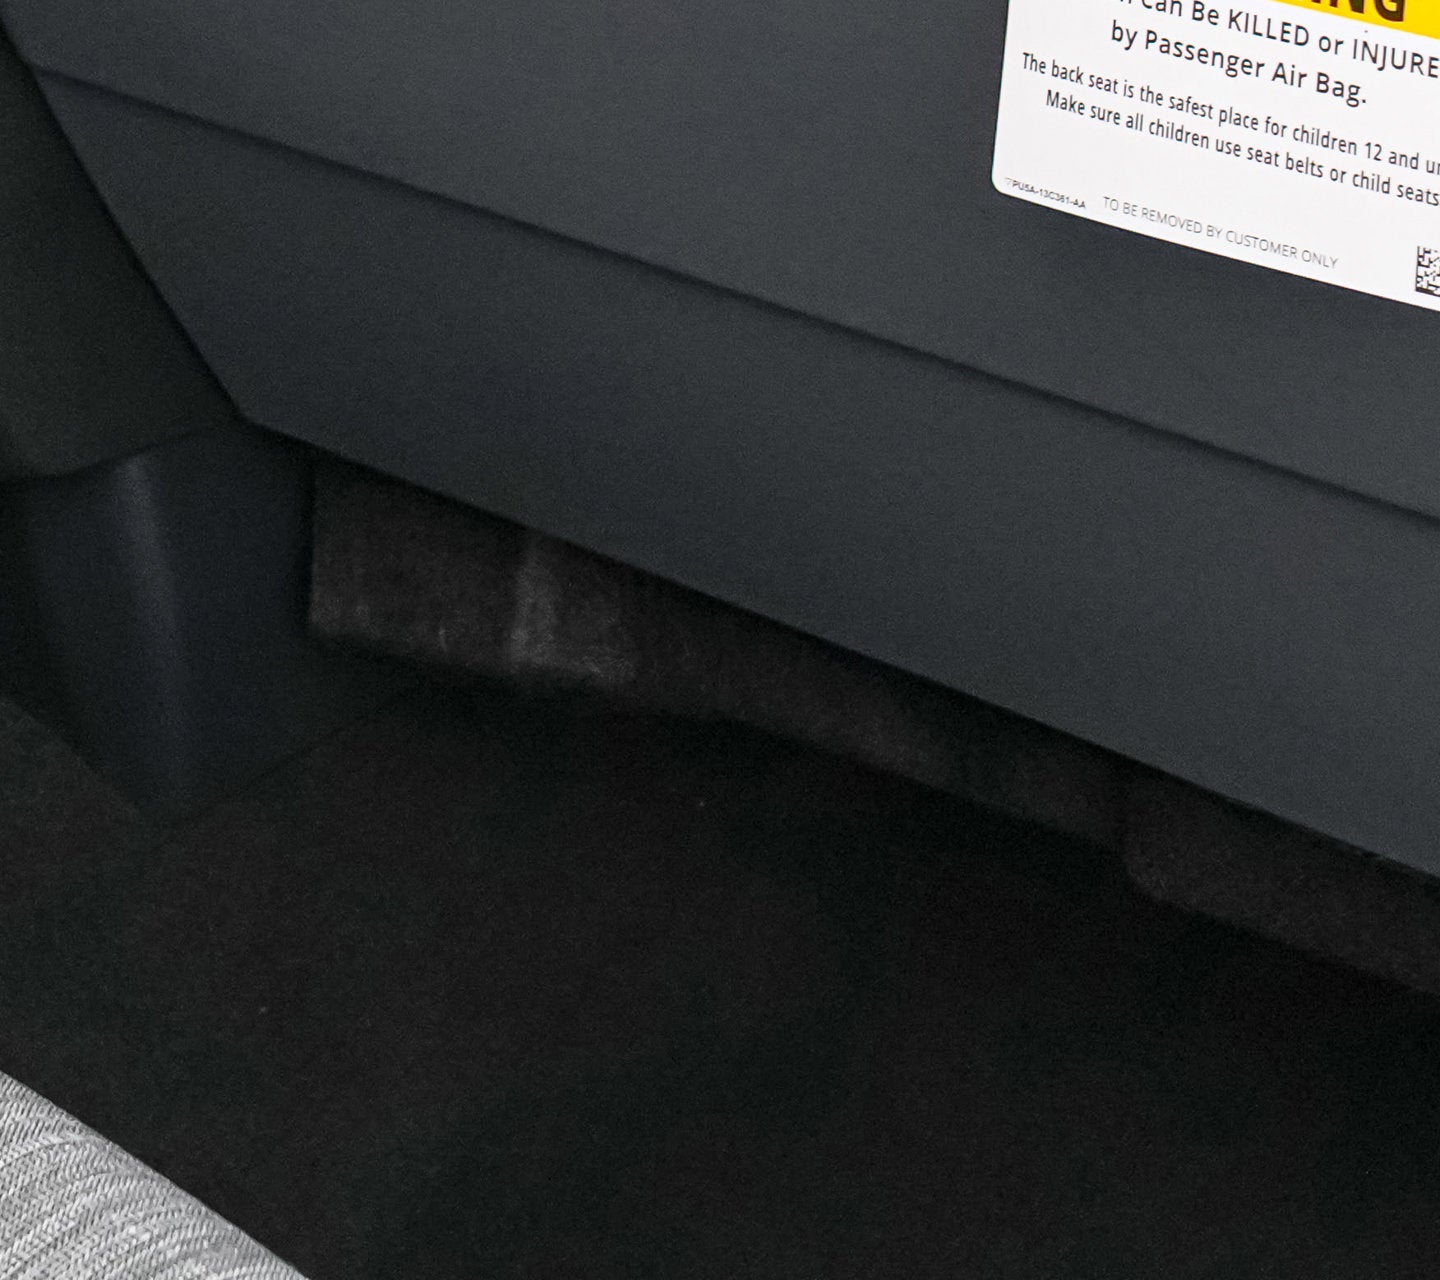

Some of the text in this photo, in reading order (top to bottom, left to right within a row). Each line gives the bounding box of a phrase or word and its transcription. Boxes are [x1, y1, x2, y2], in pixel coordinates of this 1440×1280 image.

[1112, 19, 1366, 108] by Passenger Air Bag.
[1192, 0, 1219, 26] Be
[1228, 8, 1309, 46] KILLED
[1319, 36, 1344, 55] or
[1023, 52, 1046, 74] The
[1051, 59, 1084, 85] back
[1088, 74, 1118, 94] seat
[1123, 79, 1134, 98] is
[1140, 85, 1163, 106] the
[1168, 96, 1214, 119] safest
[1219, 106, 1259, 131] place
[1265, 116, 1287, 137] for
[1293, 124, 1357, 155] children
[1365, 142, 1382, 161] 12
[1388, 151, 1419, 170] and
[1046, 89, 1085, 116] Make
[1090, 106, 1120, 125] sure
[1126, 112, 1143, 132] all
[1149, 118, 1209, 149] children
[1216, 138, 1241, 157] use
[1246, 147, 1280, 167] seat
[1285, 152, 1324, 178] belts
[1330, 168, 1347, 183] or
[1352, 170, 1390, 194] child
[1103, 195, 1340, 269] TO BE REMOVED BY CUSTOMER ONLY
